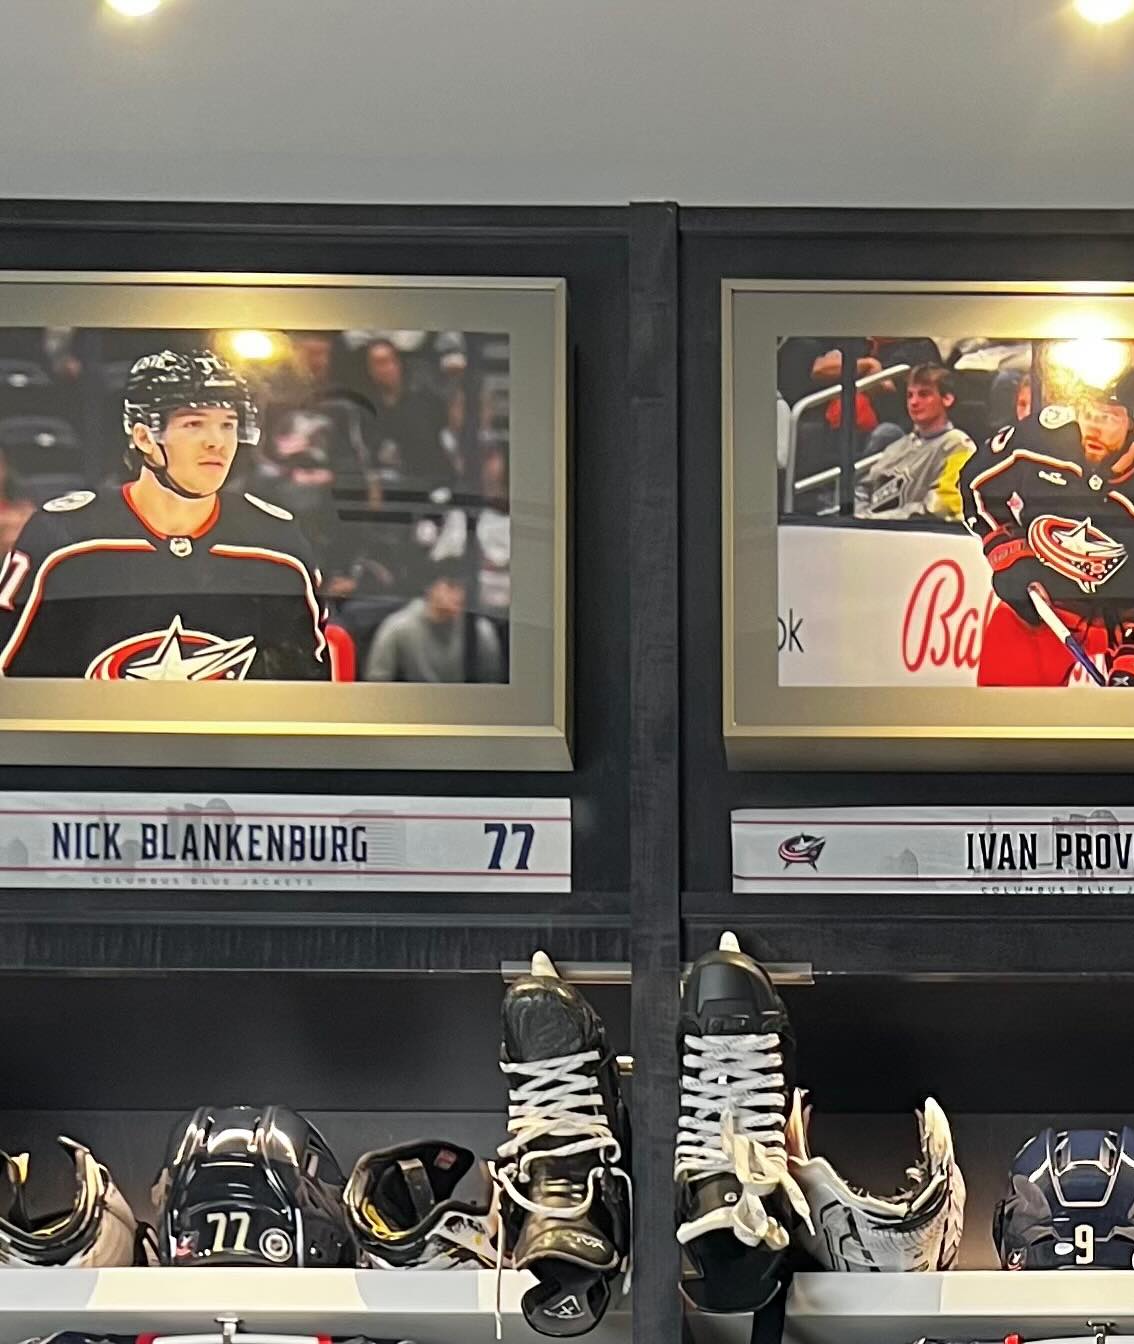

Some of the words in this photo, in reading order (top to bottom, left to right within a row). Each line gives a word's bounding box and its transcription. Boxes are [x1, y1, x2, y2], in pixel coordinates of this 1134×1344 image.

[52, 822, 122, 860] NICK
[141, 823, 368, 863] BLANKENBURG
[484, 822, 535, 870] 77
[967, 832, 1037, 871] IVAN
[206, 1211, 250, 1252] 77
[1074, 1223, 1095, 1265] 9
